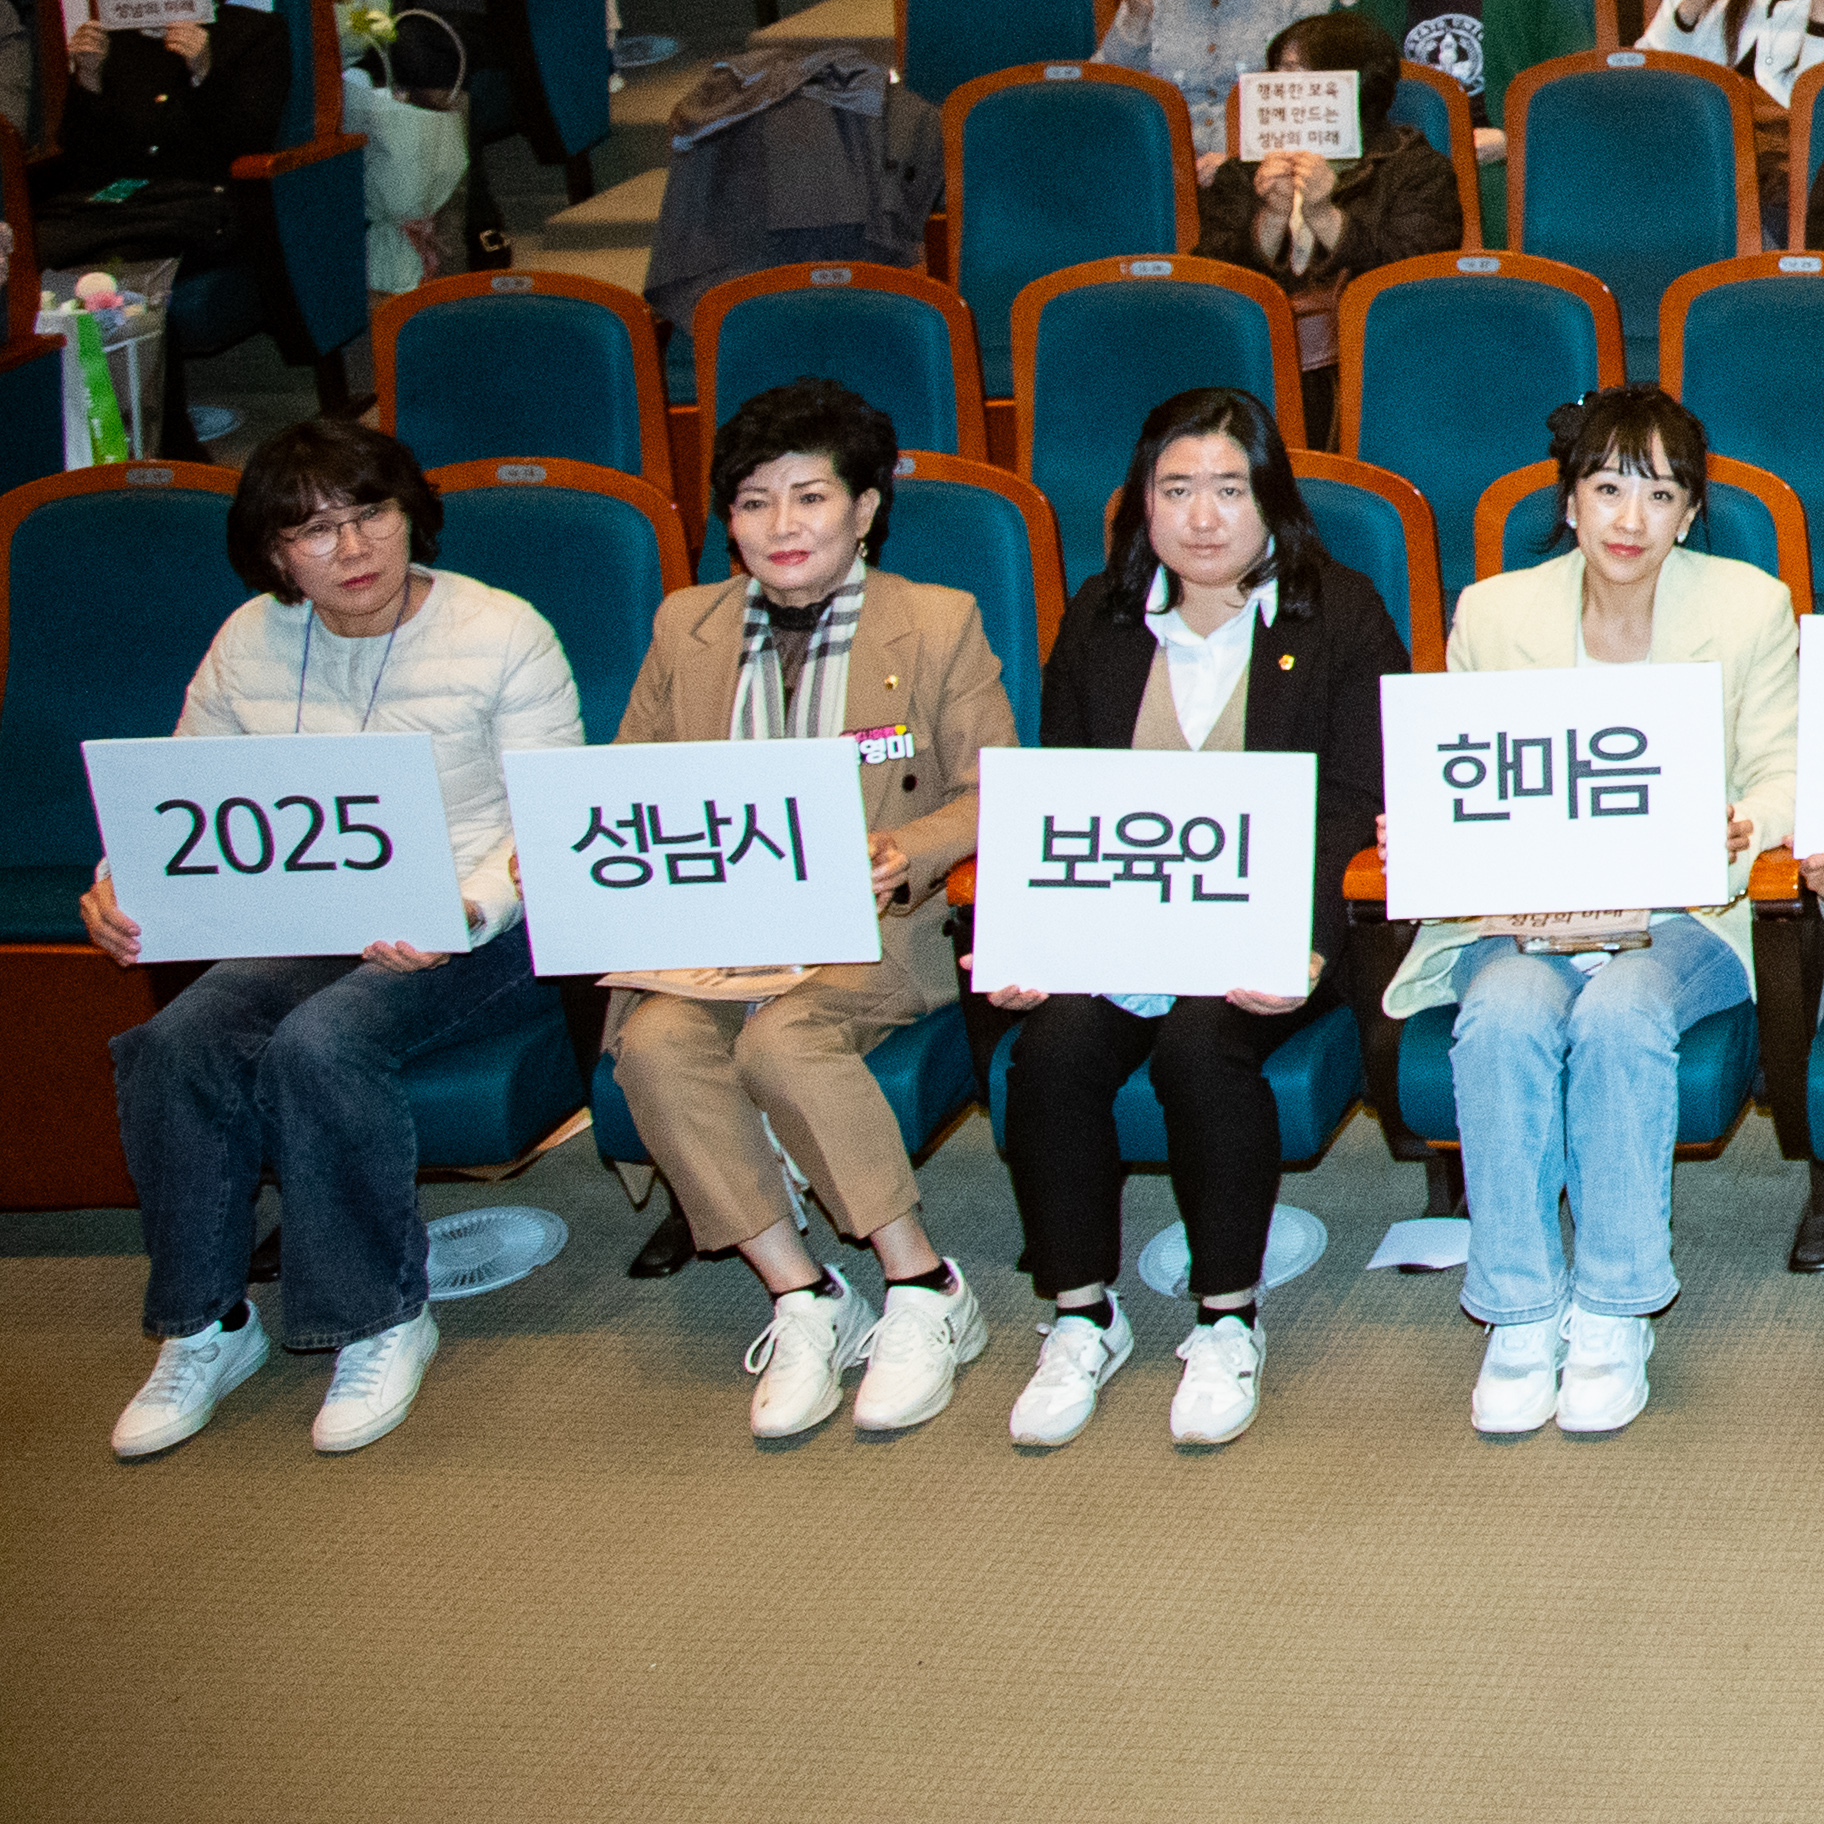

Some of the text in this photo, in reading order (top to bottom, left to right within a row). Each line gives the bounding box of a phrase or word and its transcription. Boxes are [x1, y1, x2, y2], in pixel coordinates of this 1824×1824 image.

[1257, 81, 1338, 100] 행복한 보육
[1257, 106, 1338, 124] 함께 만드는
[1257, 130, 1339, 148] 성남의 미래
[857, 733, 914, 764] 영미
[1438, 728, 1660, 821] 한마음
[155, 795, 393, 876] 2025
[572, 798, 806, 888] 성남시
[1029, 813, 1249, 902] 보육인
